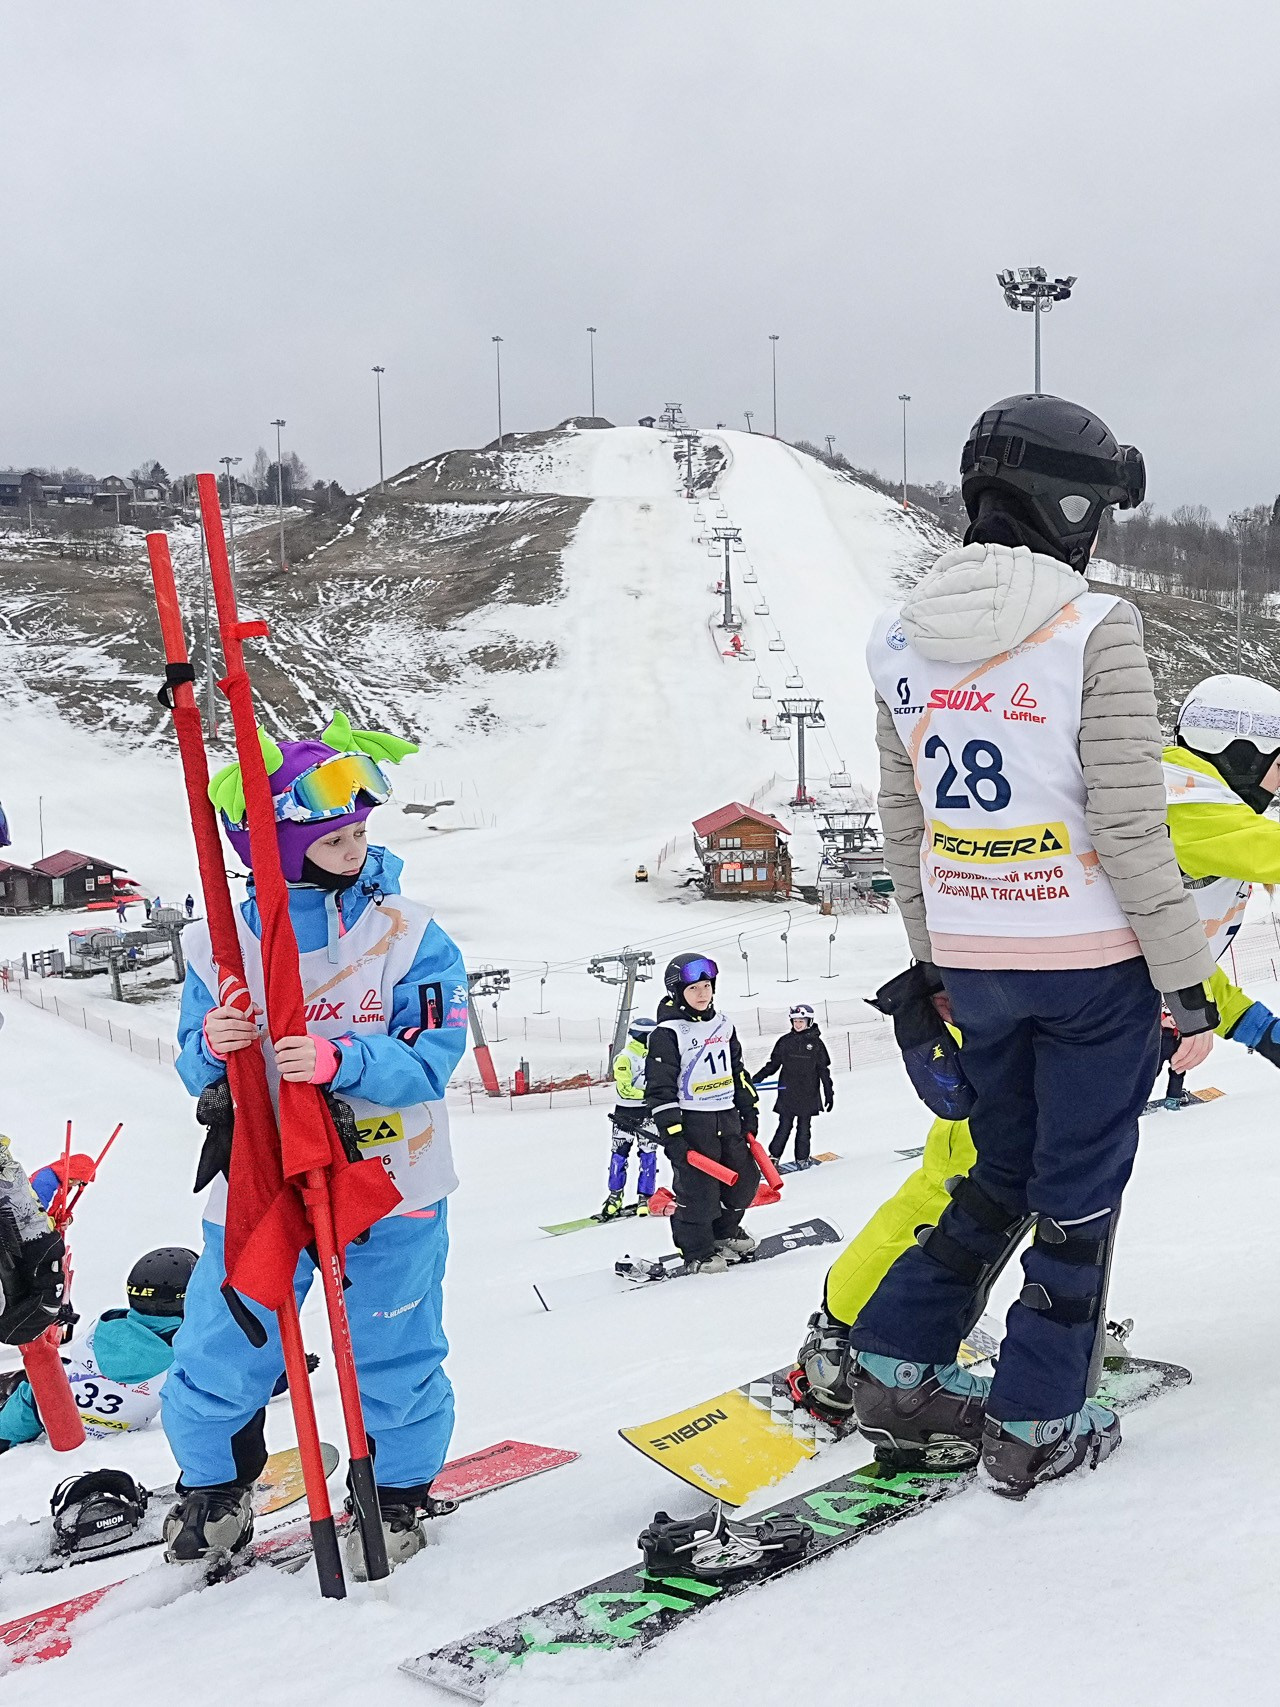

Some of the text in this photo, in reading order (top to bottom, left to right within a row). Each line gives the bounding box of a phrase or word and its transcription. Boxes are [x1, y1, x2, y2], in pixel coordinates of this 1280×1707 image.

[893, 706, 925, 715] SCOTT
[1003, 709, 1047, 724] Löffler
[924, 735, 1012, 813] 28
[933, 832, 1037, 858] FISCHER
[1024, 866, 1064, 882] клуб
[991, 884, 1071, 901] ТЯГАЧЁВА
[352, 1014, 385, 1023] Löffle
[704, 1049, 728, 1075] 11
[75, 1382, 124, 1415] 33
[649, 1408, 729, 1451] NOBILE
[96, 1514, 124, 1529] UNION
